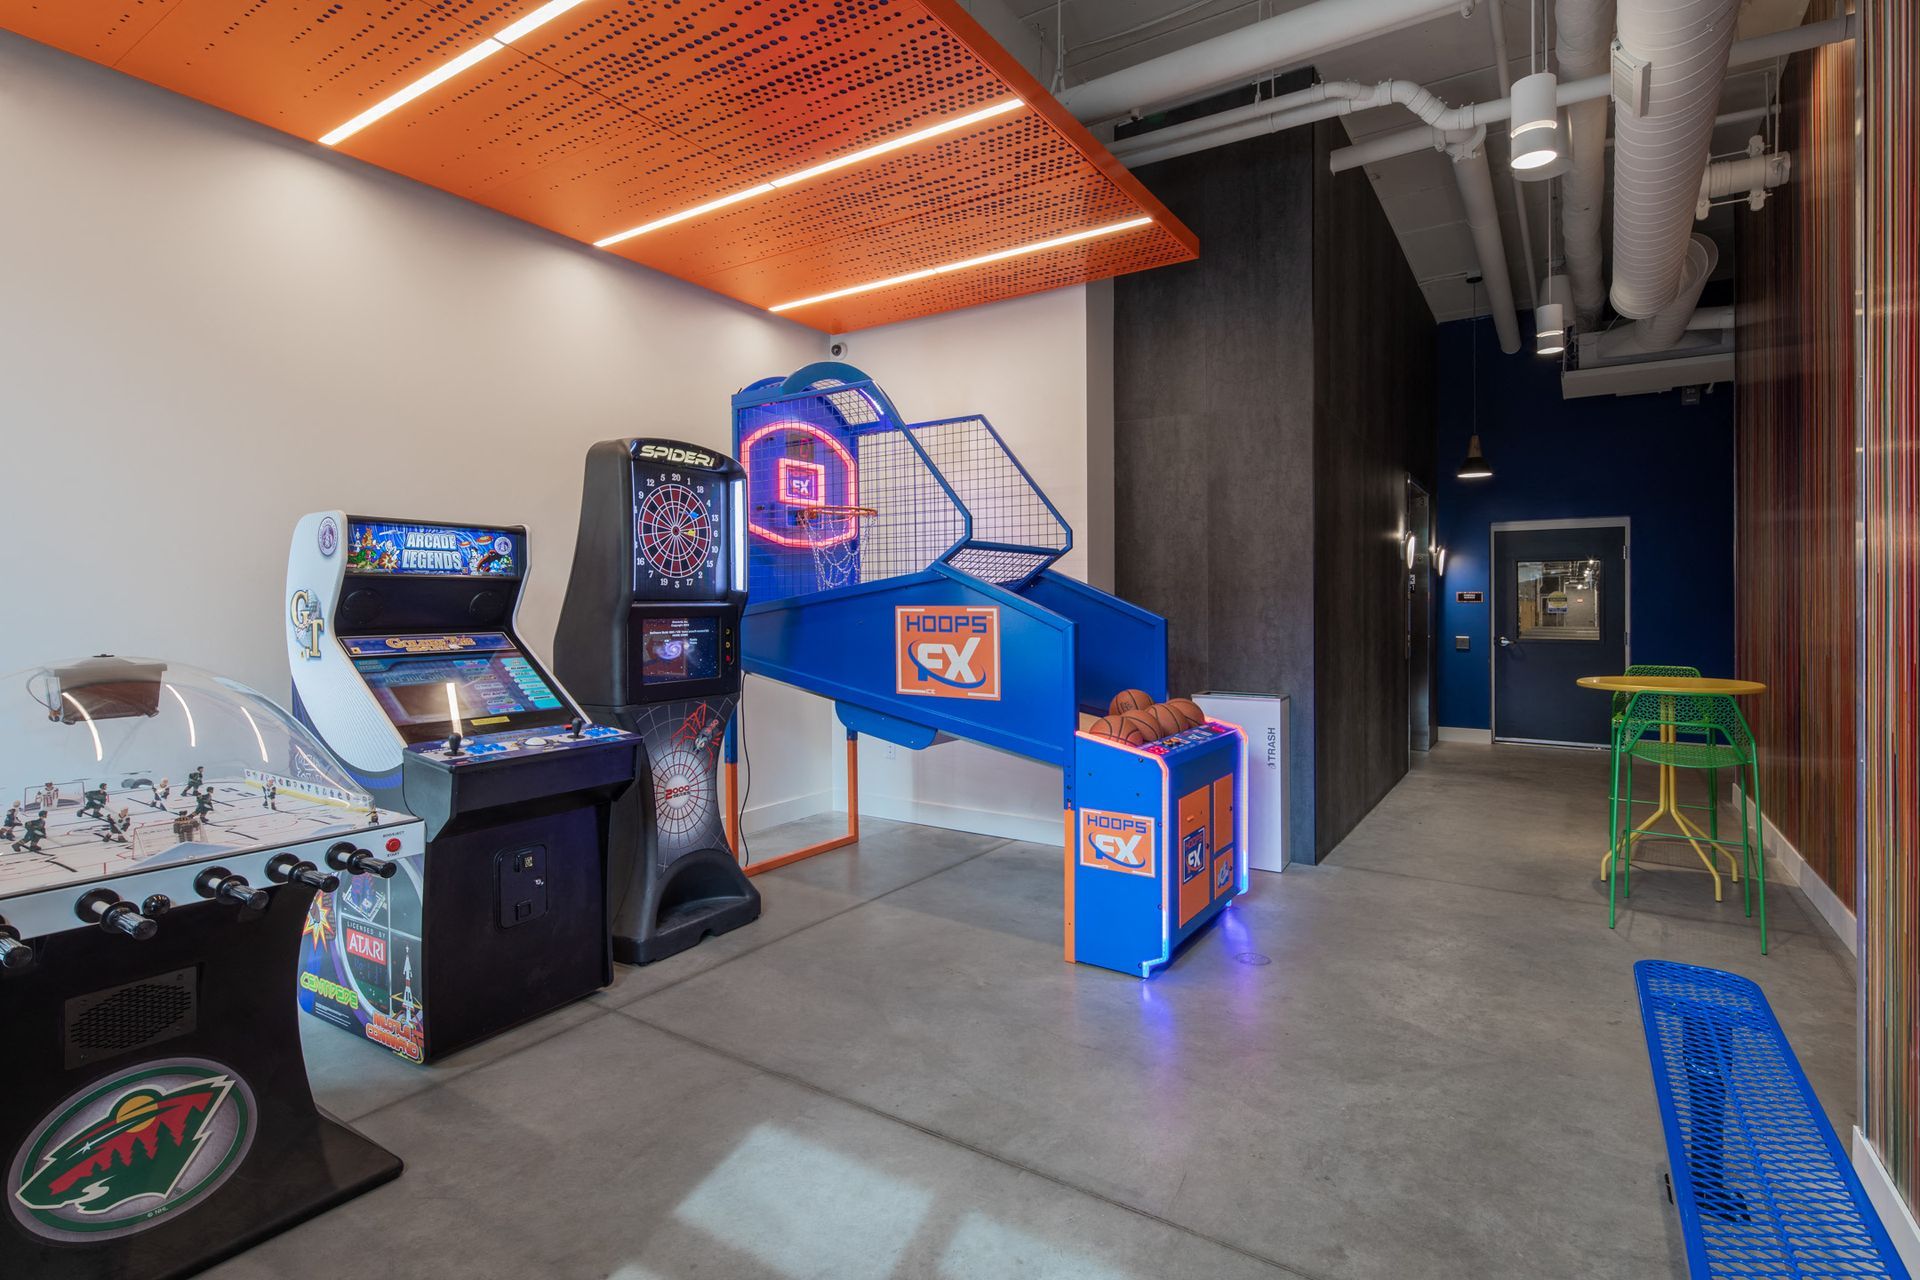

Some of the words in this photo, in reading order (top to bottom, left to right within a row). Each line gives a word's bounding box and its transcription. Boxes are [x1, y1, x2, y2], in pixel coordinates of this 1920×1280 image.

[660, 473, 666, 482] 5
[671, 473, 681, 482] 20
[686, 477, 691, 485] 1
[646, 478, 655, 487] 12
[696, 485, 704, 494] 18
[638, 491, 644, 499] 9
[706, 499, 711, 507] 4
[713, 529, 719, 538] 6
[406, 532, 457, 549] ARCADE
[711, 545, 719, 554] 10
[401, 549, 464, 570] LEGENDS
[636, 557, 645, 566] 16
[706, 560, 714, 568] 15
[648, 570, 654, 578] 7
[698, 571, 703, 579] 2
[660, 578, 669, 586] 19
[686, 578, 694, 586] 17
[906, 615, 987, 633] HOOPS
[917, 637, 981, 684] FX
[1267, 727, 1276, 762] TRASH
[1087, 815, 1147, 834] HOOPS
[1095, 834, 1142, 866] FX
[347, 921, 374, 935] LICENSED
[379, 930, 386, 938] BY
[349, 933, 385, 961] ATARI
